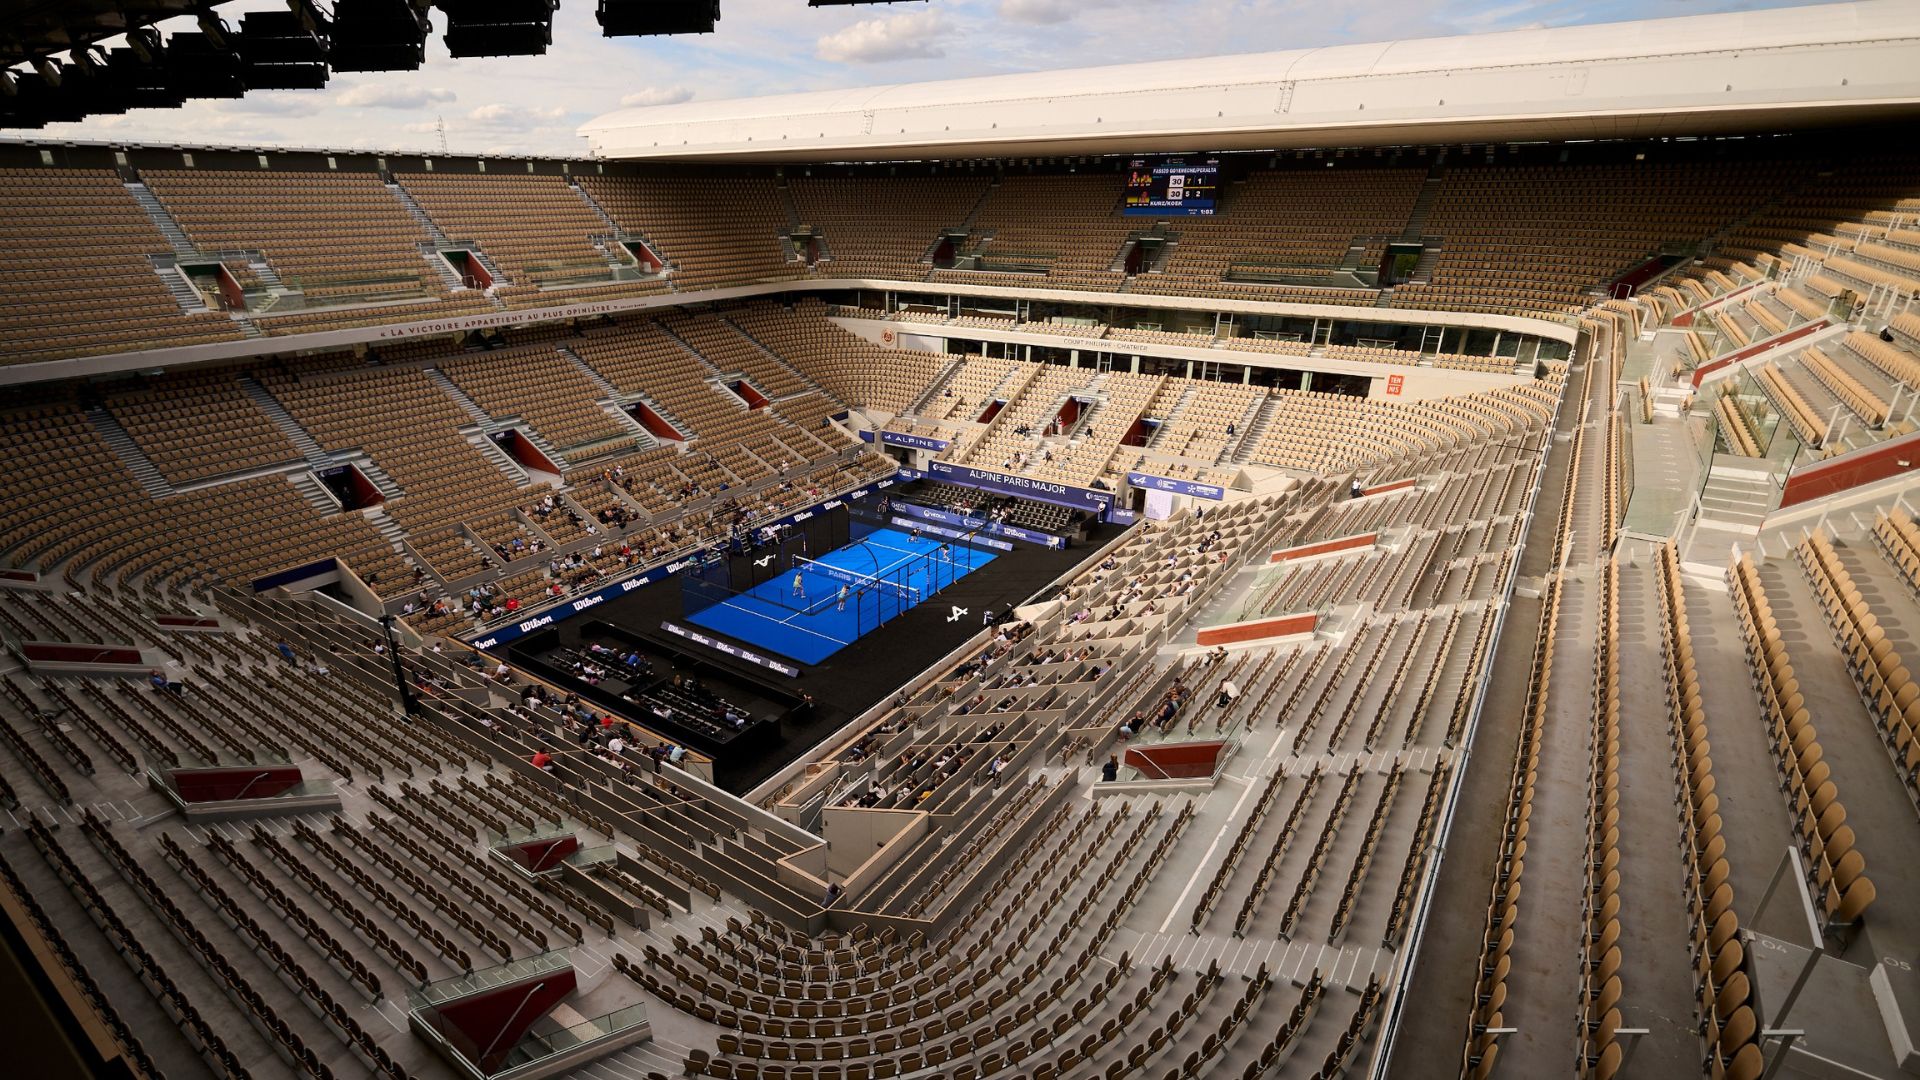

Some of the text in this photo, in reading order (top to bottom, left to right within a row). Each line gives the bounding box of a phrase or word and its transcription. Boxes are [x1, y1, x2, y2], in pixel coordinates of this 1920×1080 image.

[391, 328, 404, 337] LA
[409, 322, 460, 334] VICTOIRE
[464, 315, 523, 328] APPARTIENT
[543, 310, 563, 318] PLUS
[567, 305, 610, 315] OPINIÂTRE
[1063, 338, 1084, 346] COURT
[1085, 340, 1111, 348] PHILIPPE
[1117, 343, 1148, 351] CHATRIER
[895, 436, 934, 447] ALPINE
[969, 469, 1066, 495] ALPINE PARIS MAJOR
[824, 500, 842, 510] Wilson
[1003, 527, 1027, 539] Wilson
[829, 570, 851, 581] PARIS
[621, 576, 650, 591] Wilson
[573, 594, 604, 611] Wilson
[520, 614, 553, 633] Wilson
[475, 638, 497, 649] lson
